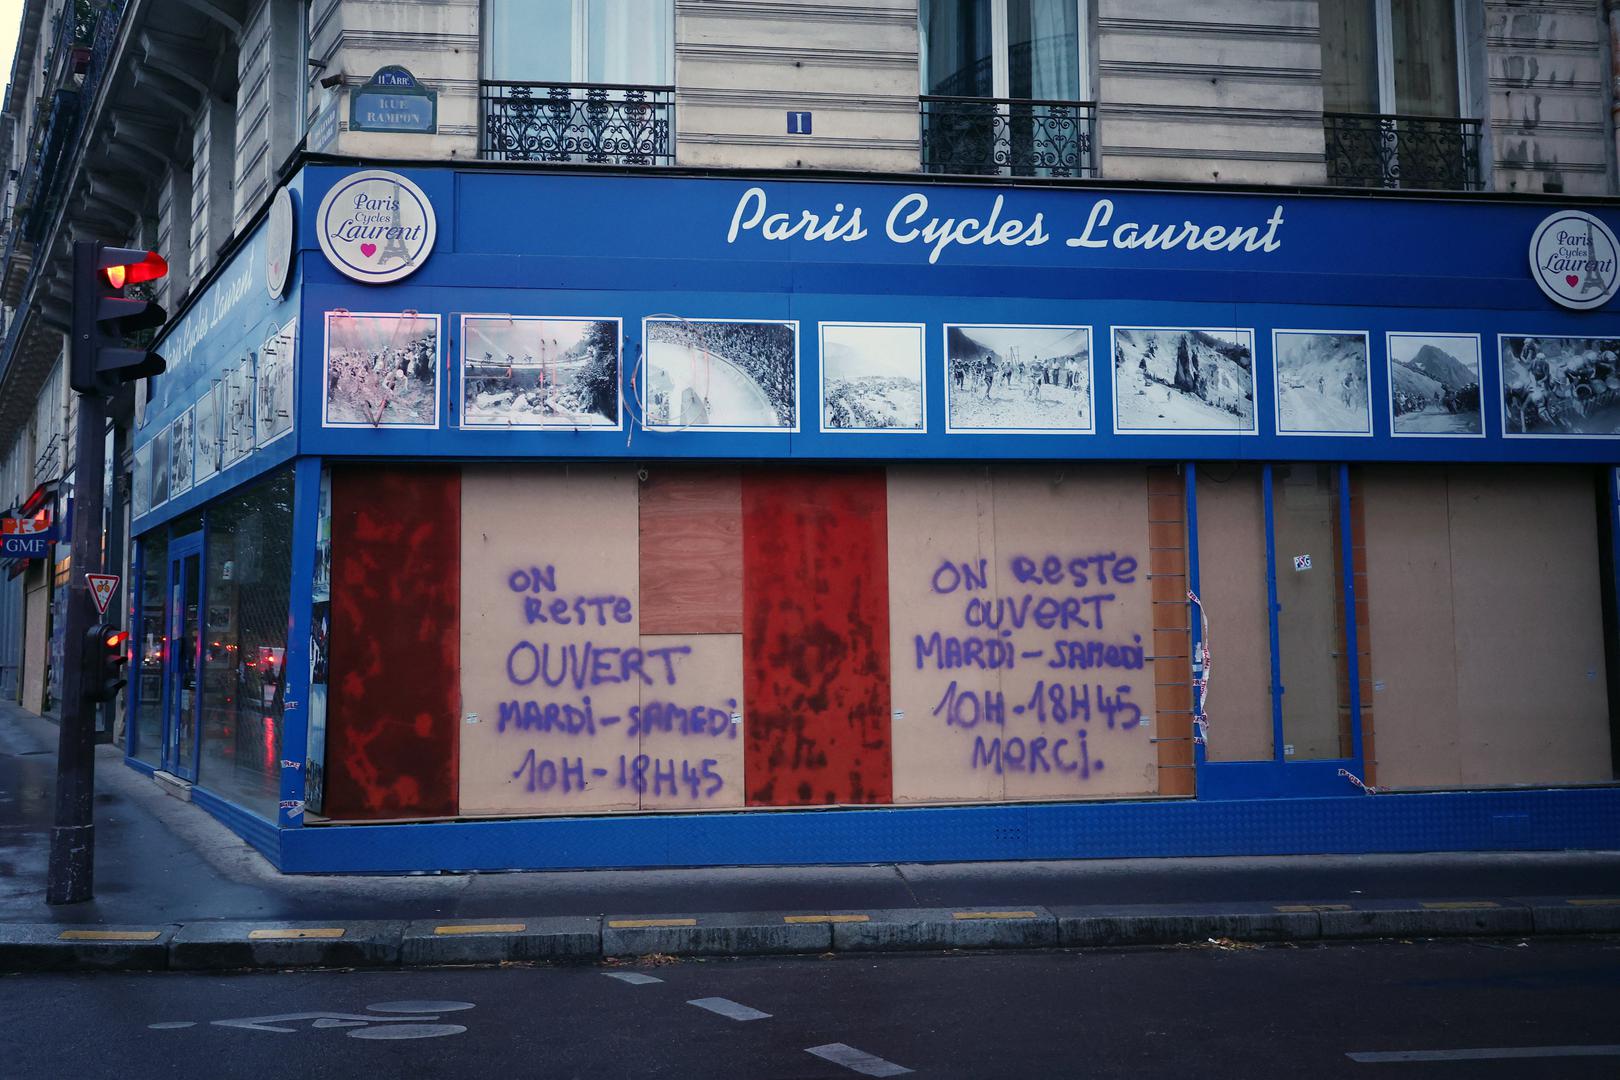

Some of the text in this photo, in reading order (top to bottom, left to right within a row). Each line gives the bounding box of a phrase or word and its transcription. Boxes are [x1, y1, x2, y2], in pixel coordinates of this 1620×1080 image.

[380, 98, 408, 109] RUE
[367, 112, 419, 123] RAMPON
[353, 193, 400, 211] Paris
[354, 211, 391, 224] Cycles
[727, 187, 1284, 264] Paris Cycles Laurent
[331, 219, 422, 242] Laurent
[1556, 230, 1593, 246] Paris
[1558, 246, 1588, 258] Cycles
[1541, 253, 1612, 274] Laurent
[6, 539, 45, 552] GMF
[1294, 555, 1312, 568] PSG
[508, 565, 557, 593] ON
[932, 558, 988, 594] ON
[507, 640, 691, 690] OUVERT
